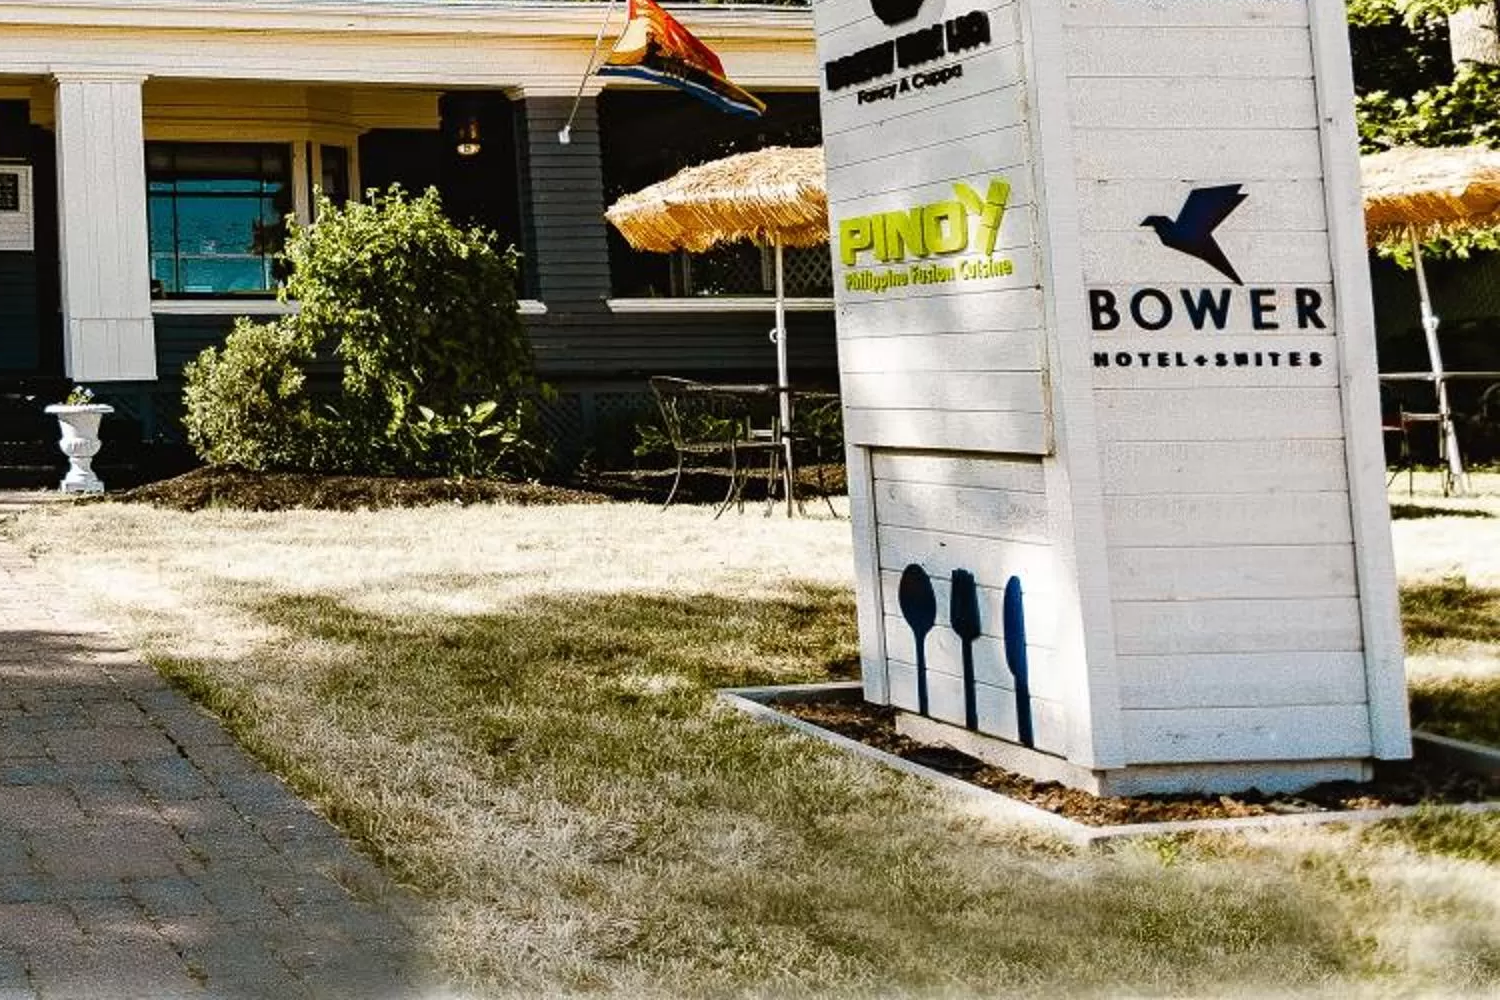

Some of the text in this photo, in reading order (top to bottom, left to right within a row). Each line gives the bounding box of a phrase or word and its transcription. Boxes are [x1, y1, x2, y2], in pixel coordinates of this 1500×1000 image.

[857, 84, 897, 105] Fancy
[899, 78, 910, 93] A
[912, 64, 963, 89] Cuppa
[838, 175, 1011, 268] PINOY
[909, 263, 955, 285] Fusion
[959, 258, 1013, 281] Cuisine
[1088, 287, 1327, 331] BOWER
